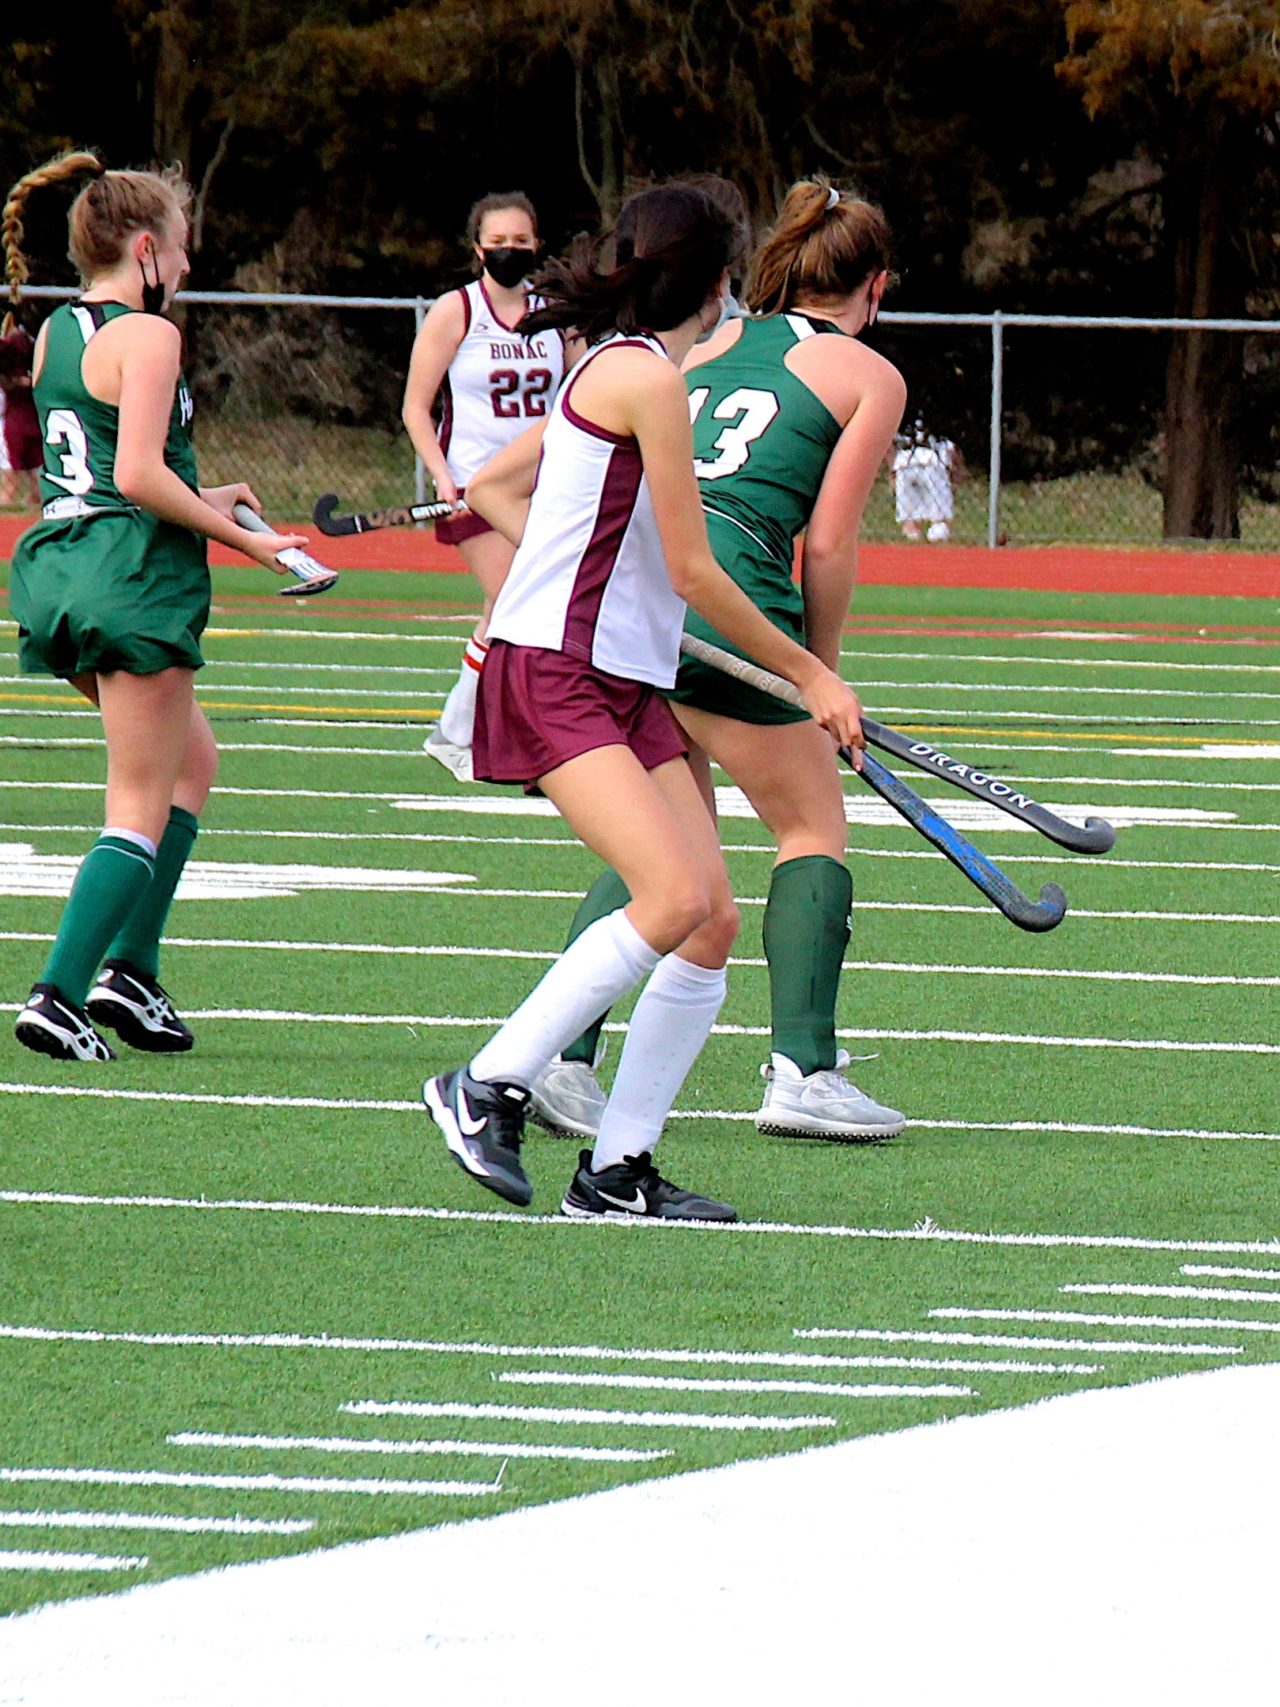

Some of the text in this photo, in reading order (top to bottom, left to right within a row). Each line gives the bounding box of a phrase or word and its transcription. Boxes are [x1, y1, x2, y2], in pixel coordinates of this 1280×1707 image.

[489, 341, 548, 360] BONAC
[488, 368, 552, 418] 22
[45, 409, 95, 495] 3
[908, 742, 1035, 810] DRAGON
